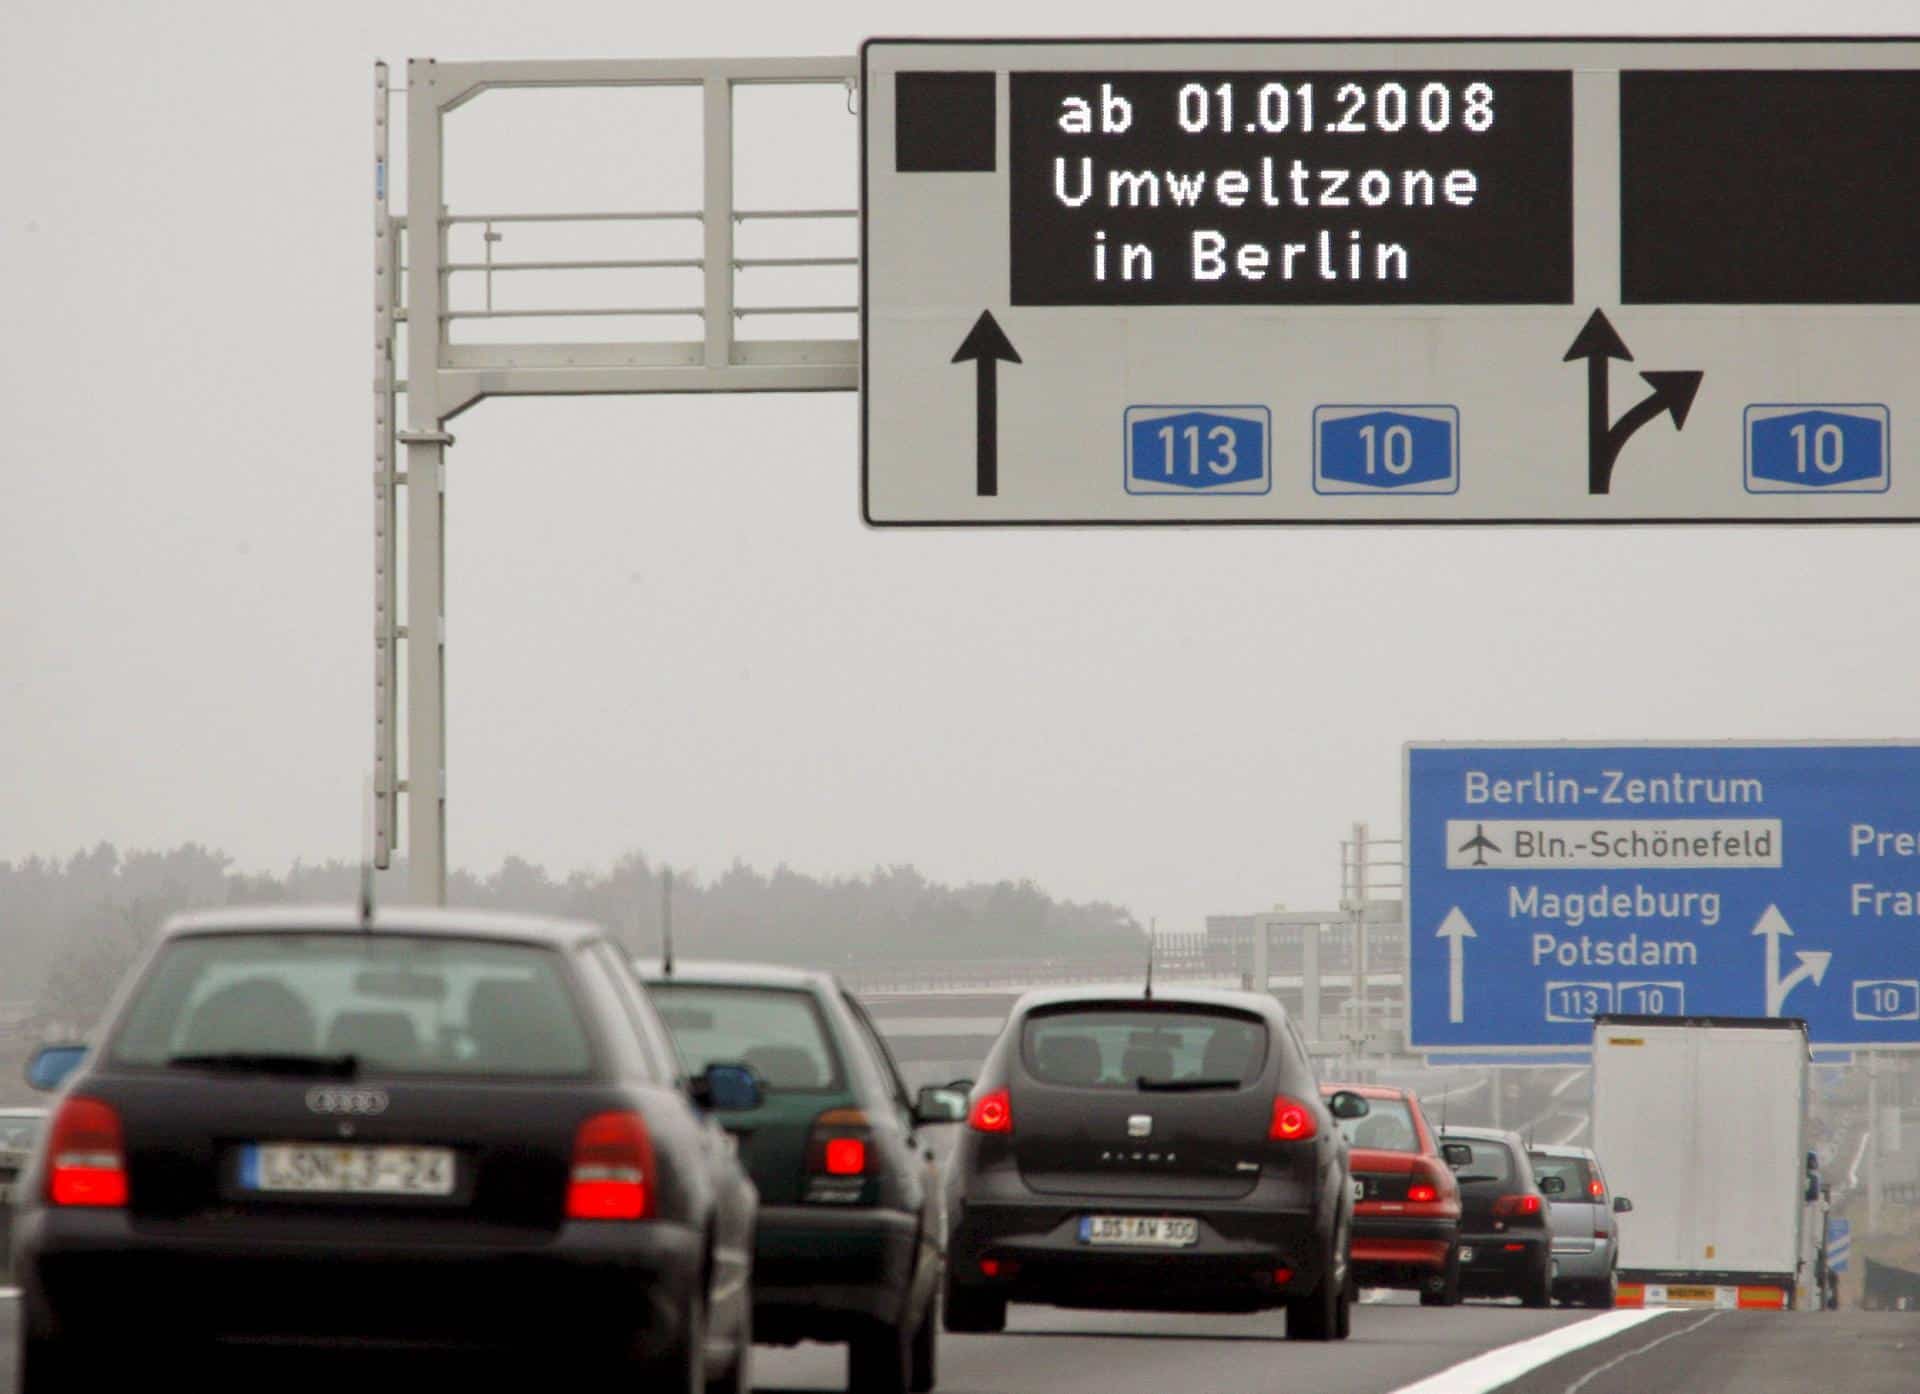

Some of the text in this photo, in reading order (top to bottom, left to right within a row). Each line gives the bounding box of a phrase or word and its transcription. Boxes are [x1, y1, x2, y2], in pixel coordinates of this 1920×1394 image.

[1058, 83, 1494, 134] ab 01.01.2008
[1055, 157, 1478, 207] Umweltzone
[1095, 230, 1408, 281] in Berlin
[1158, 425, 1237, 475] 113
[1359, 425, 1412, 475] 10
[1790, 424, 1843, 473] 10
[1465, 771, 1763, 804] Berlin-Zentrum
[1514, 829, 1772, 859] Bln.-Schönefeld
[1852, 824, 1920, 856] Pre
[1509, 885, 1720, 926] Magdeburg
[1852, 883, 1920, 916] Fra
[1533, 933, 1697, 966] Potsdam
[1560, 990, 1599, 1014] 113
[1638, 989, 1664, 1014] 10
[1872, 988, 1899, 1012] 10
